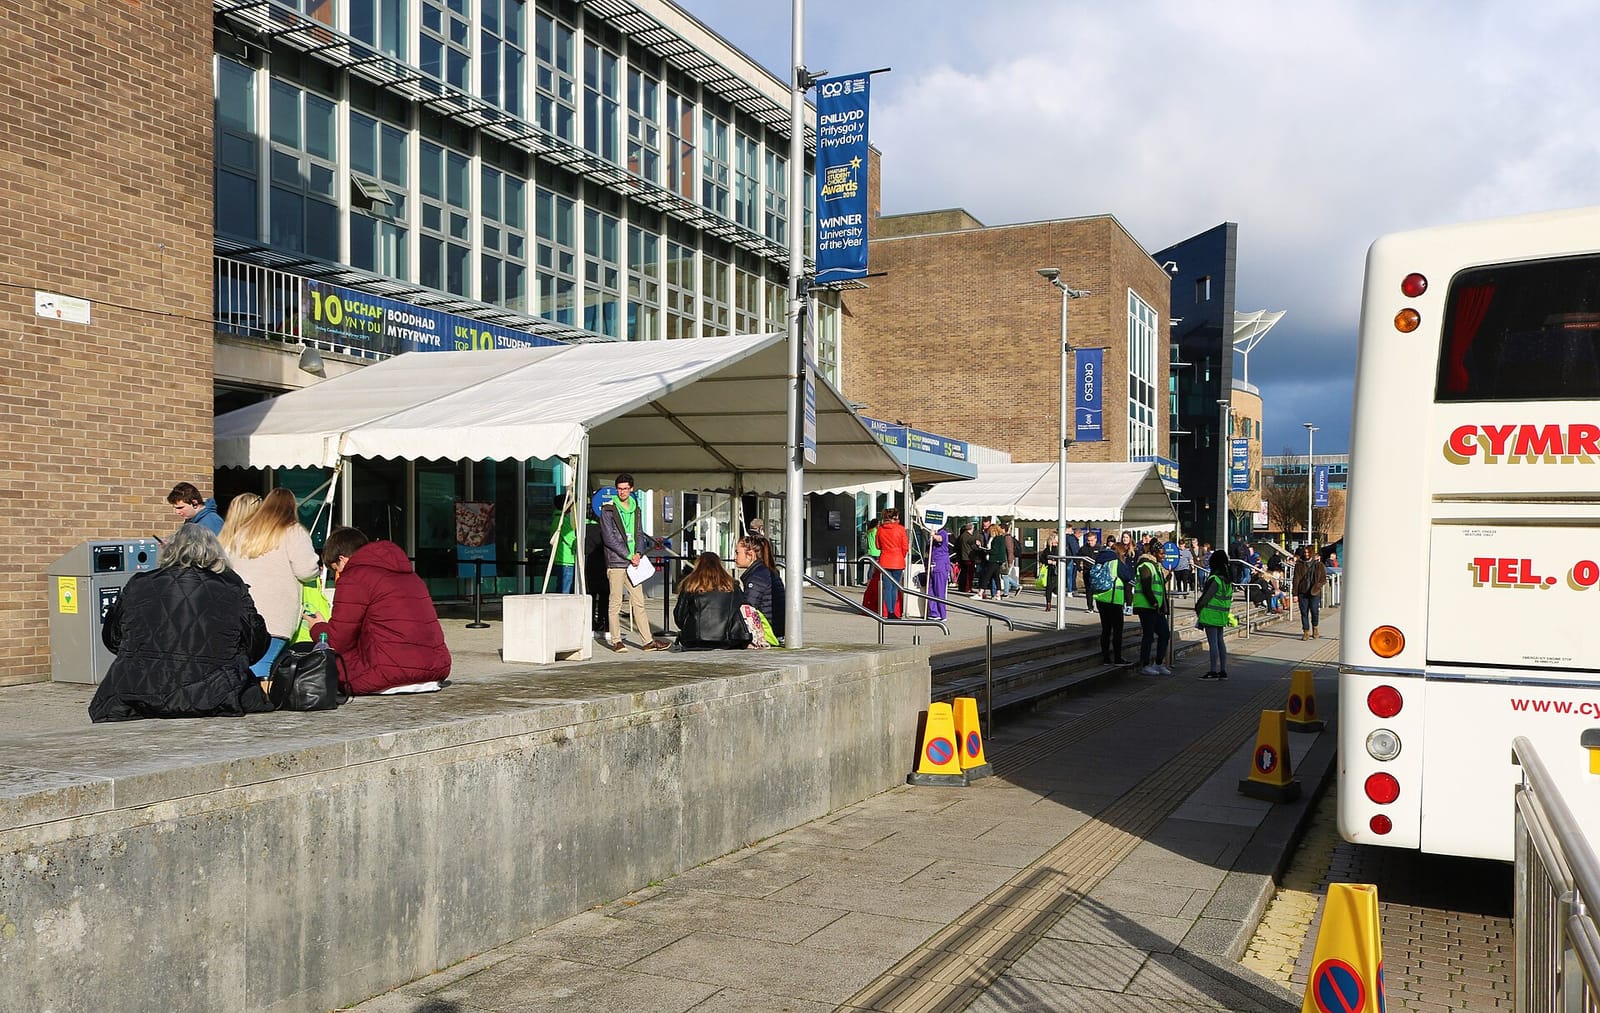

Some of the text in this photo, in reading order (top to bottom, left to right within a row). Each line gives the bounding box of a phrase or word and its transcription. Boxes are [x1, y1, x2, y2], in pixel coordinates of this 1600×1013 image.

[822, 82, 842, 95] 100
[820, 110, 864, 125] ENILLYDD
[820, 122, 864, 137] Prifysgol y
[820, 134, 863, 149] Flwyddyn
[821, 180, 858, 196] Awards
[820, 213, 862, 229] WINNER
[820, 226, 863, 240] University
[820, 236, 862, 250] of the Year
[311, 290, 342, 325] 10
[344, 298, 383, 318] UCHAF
[344, 316, 358, 330] YN
[359, 317, 366, 331] Y
[367, 319, 381, 334] DU
[388, 310, 435, 331] BODDHAD
[387, 324, 441, 347] MYFYRWYR
[455, 326, 468, 339] UK
[470, 329, 494, 351] 10
[455, 340, 469, 351] TOP
[498, 336, 532, 349] STUDENT
[1084, 363, 1094, 402] CROESO
[1446, 424, 1600, 458] CYMR
[1472, 558, 1558, 587] TEL.
[1510, 699, 1600, 719] www.cy
